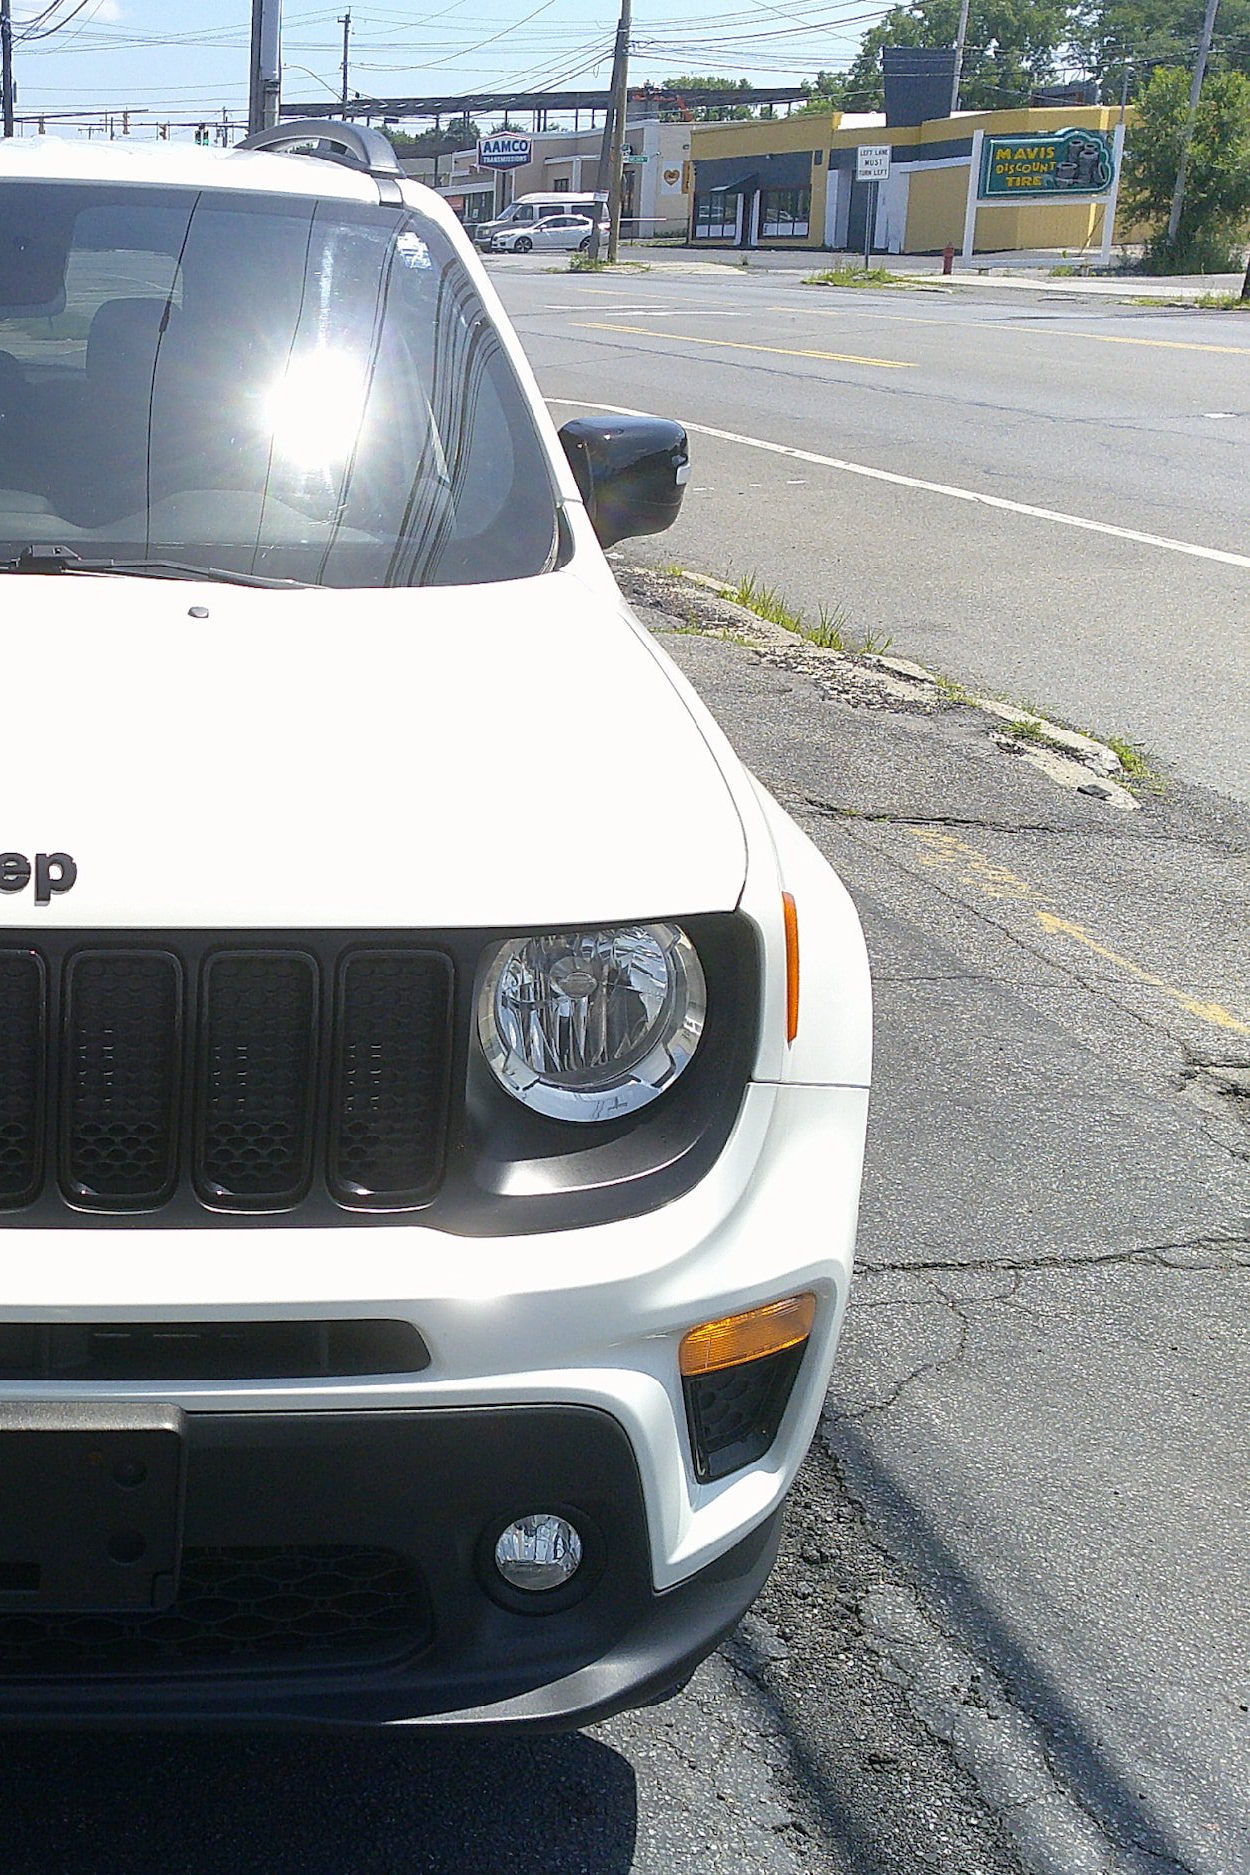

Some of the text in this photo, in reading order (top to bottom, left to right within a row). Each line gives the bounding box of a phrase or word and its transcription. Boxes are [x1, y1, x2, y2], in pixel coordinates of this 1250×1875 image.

[483, 140, 528, 153] AAMCO
[483, 155, 528, 163] TRANSMISSIONS
[995, 147, 1055, 160] MAVIS
[995, 162, 1056, 174] DISCOUNT
[1005, 176, 1042, 187] TIRE
